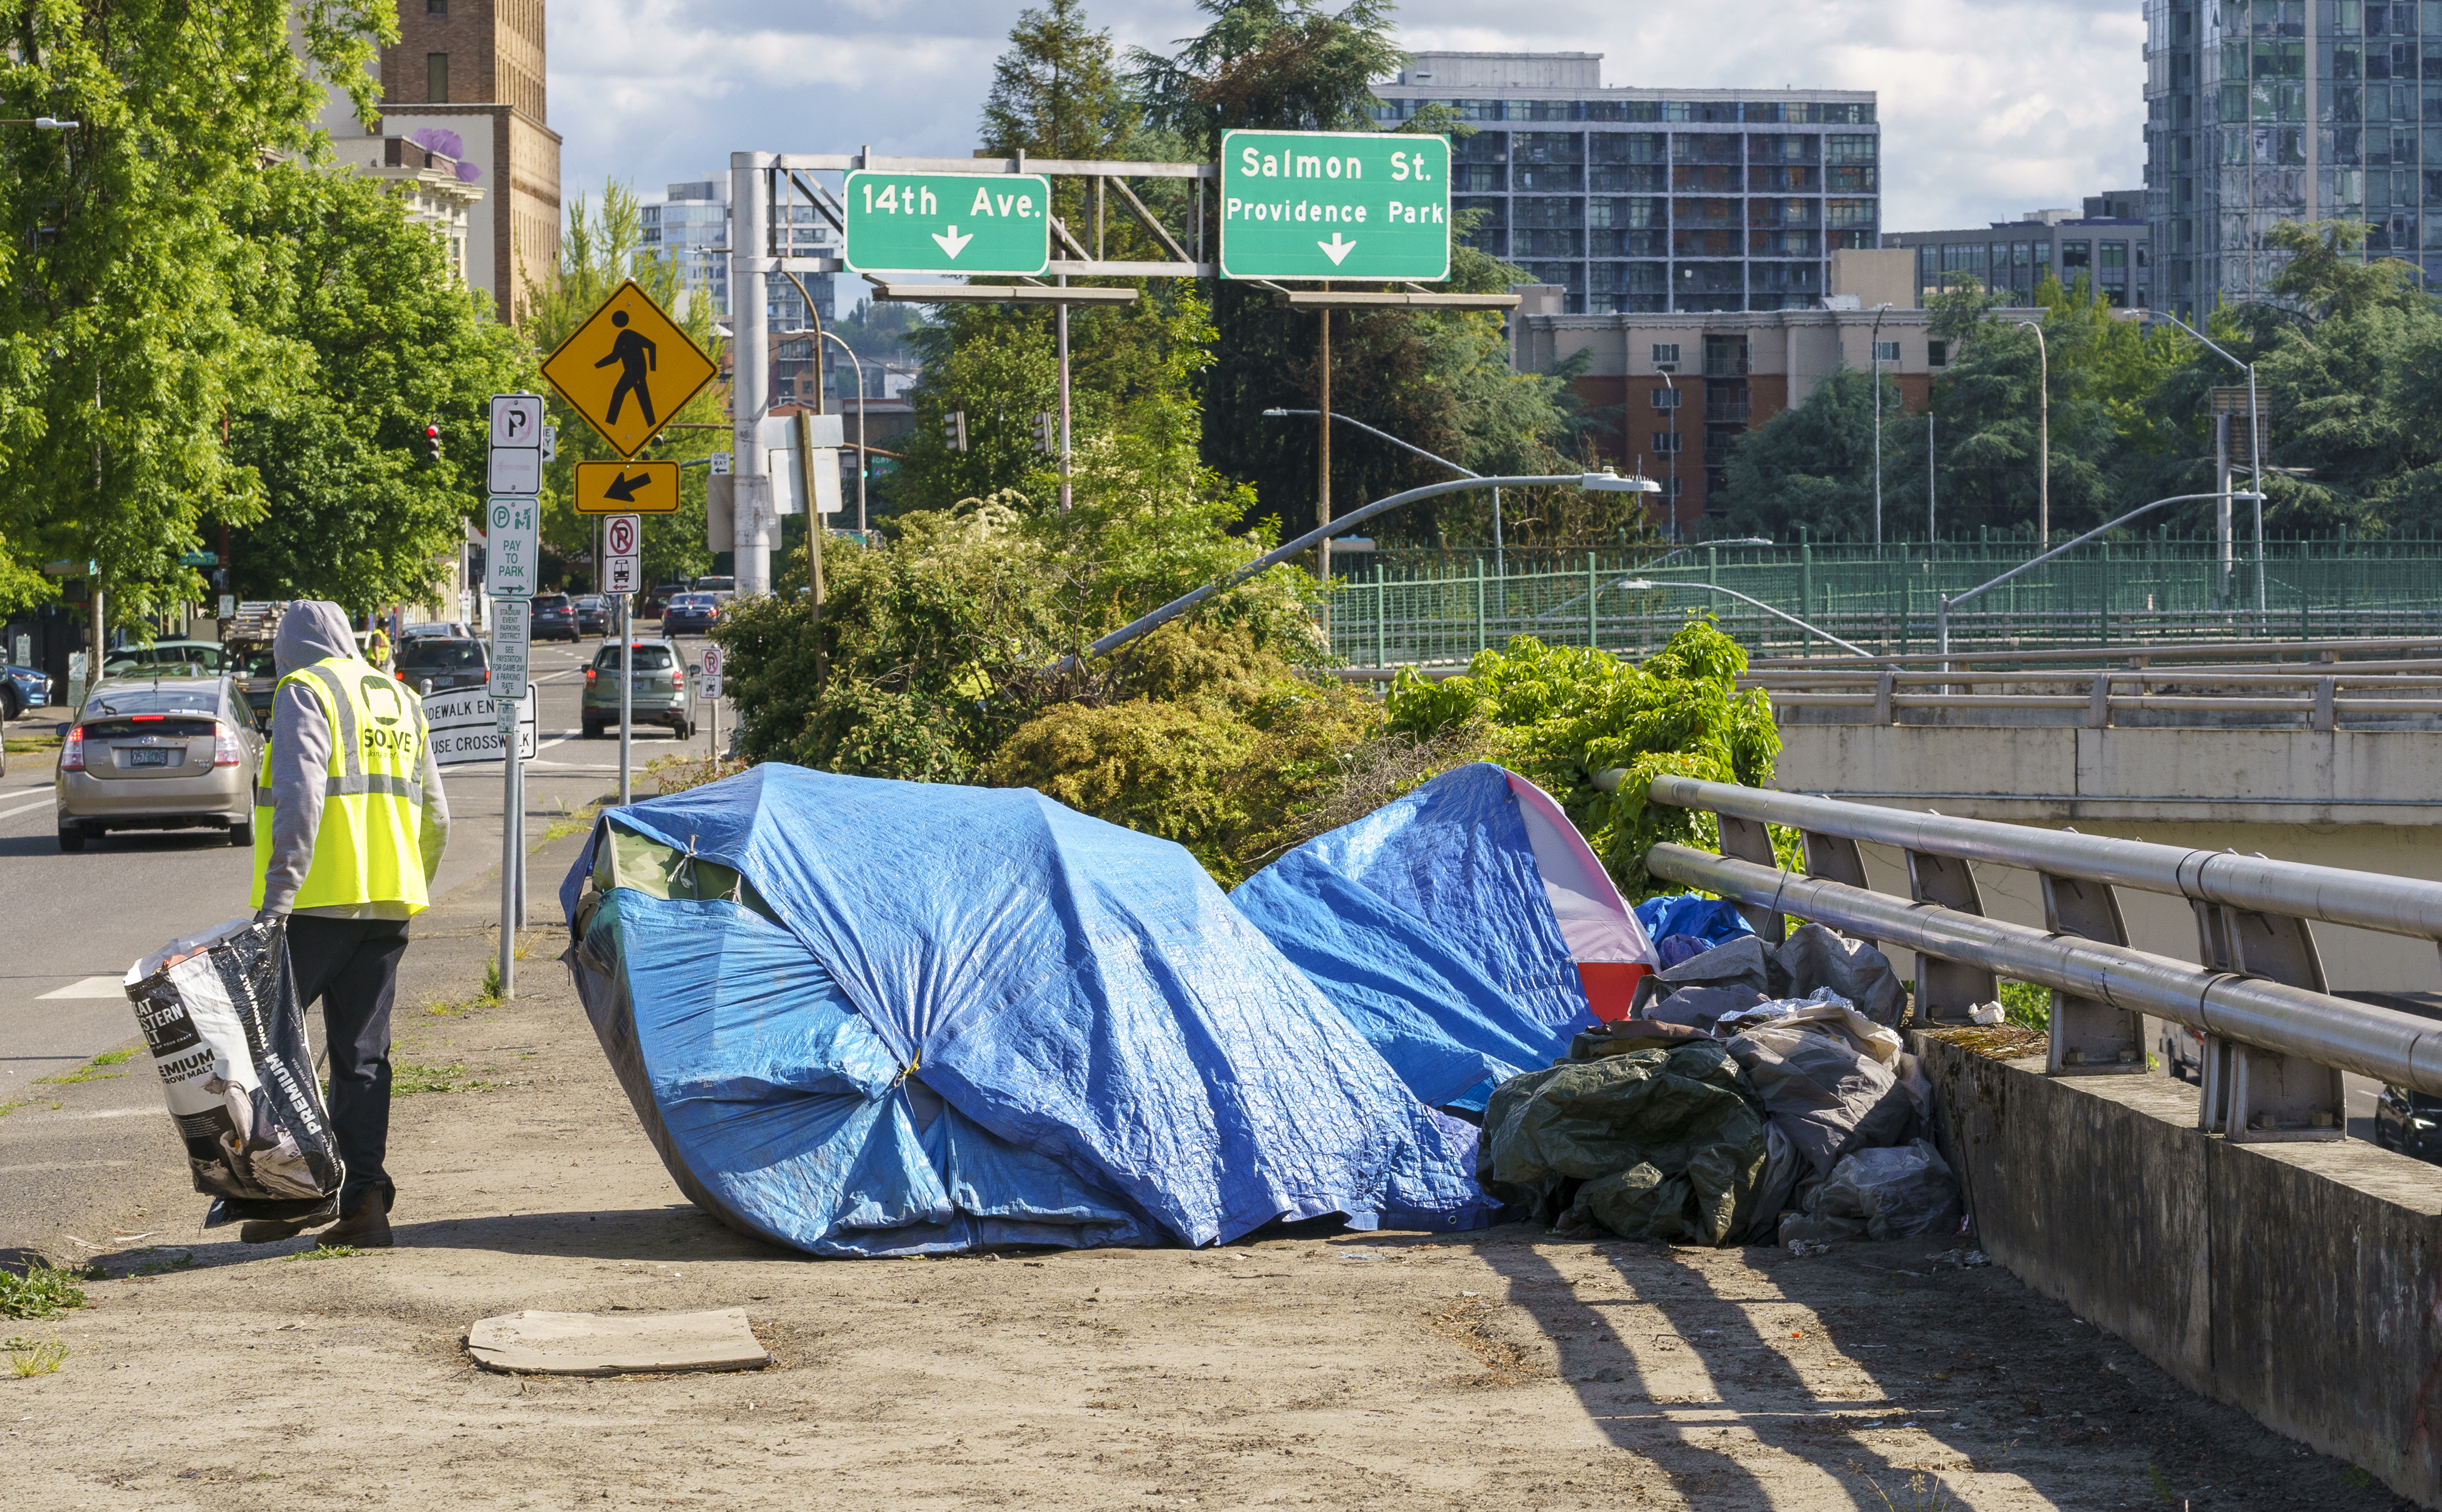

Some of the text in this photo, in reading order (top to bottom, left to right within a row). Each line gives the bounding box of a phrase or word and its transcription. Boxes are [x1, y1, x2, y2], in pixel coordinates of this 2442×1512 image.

[1240, 147, 1431, 181] Salmon St.
[862, 184, 1041, 218] 14th Ave.
[1227, 198, 1443, 224] Providence Park
[503, 540, 521, 551] PAY
[505, 553, 518, 564] TO
[499, 565, 524, 576] PARK
[496, 655, 522, 663] PAYSTATION
[502, 664, 516, 672] GAME
[500, 673, 521, 681] PARKING
[423, 702, 472, 721] IDEWALK
[432, 733, 529, 755] USE CROSSWK
[239, 973, 270, 1050] TWO ROW MALT
[176, 1033, 192, 1043] CRAFT
[164, 1063, 213, 1085] ROW MALT
[298, 1068, 307, 1081] THE
[264, 1052, 322, 1136] PREMIUM
